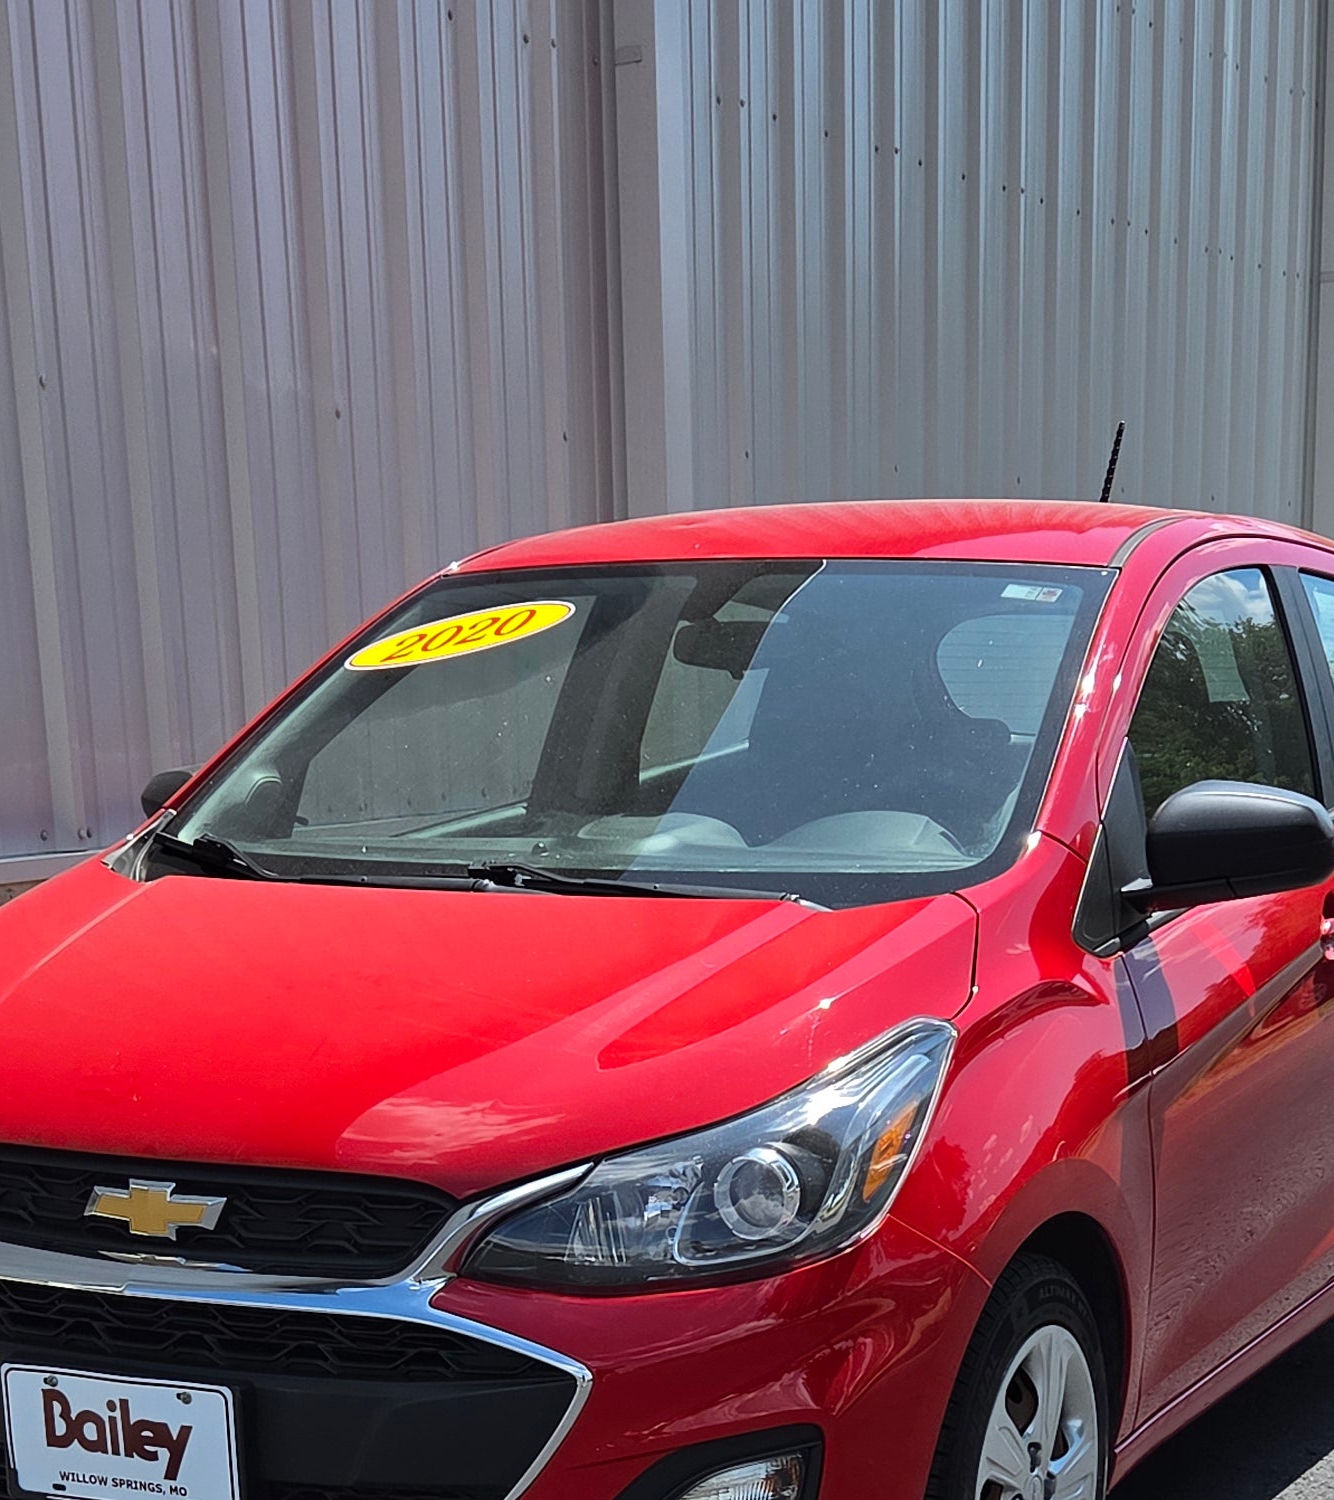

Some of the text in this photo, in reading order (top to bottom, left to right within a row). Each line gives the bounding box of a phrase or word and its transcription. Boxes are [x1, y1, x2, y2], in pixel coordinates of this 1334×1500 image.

[380, 609, 536, 662] 2020
[41, 1388, 193, 1481] Bailey
[59, 1471, 187, 1497] WILLOW SPRINGS, MO
